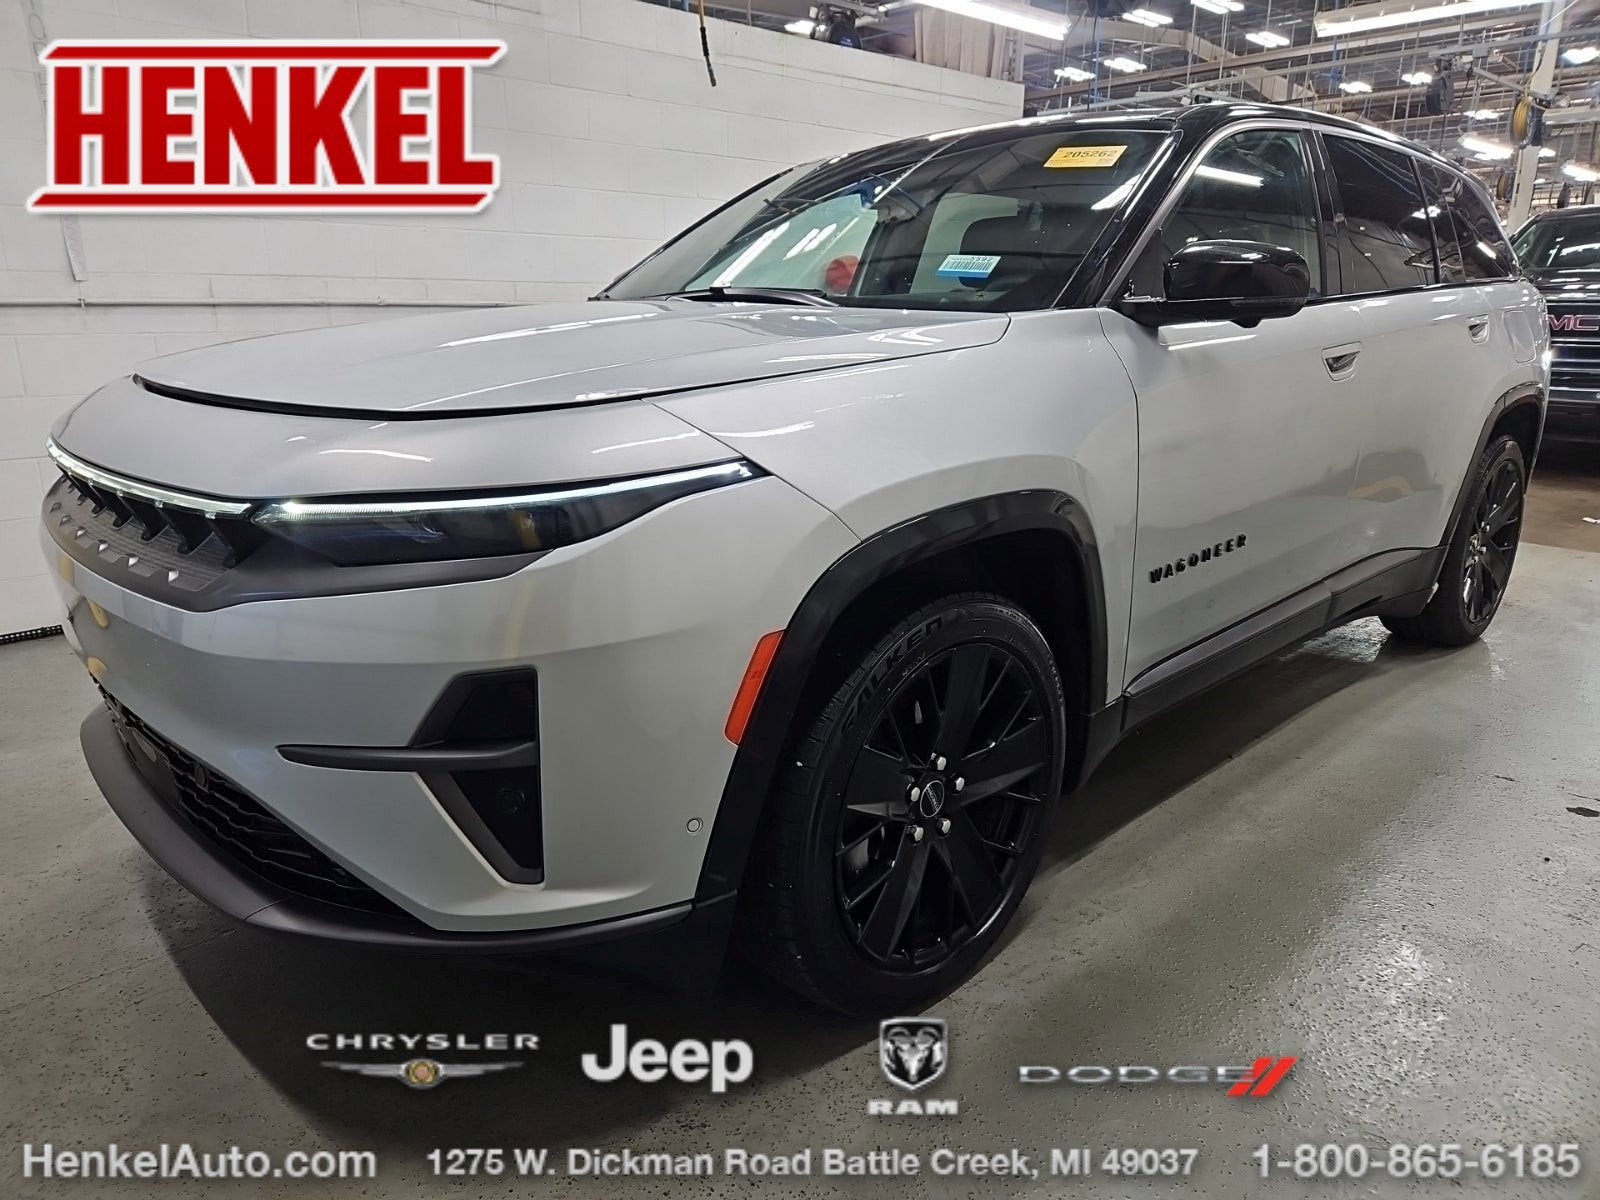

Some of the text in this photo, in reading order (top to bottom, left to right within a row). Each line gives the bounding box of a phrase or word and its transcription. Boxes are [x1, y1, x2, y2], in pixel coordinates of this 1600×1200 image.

[1063, 150, 1117, 159] 205262
[1547, 314, 1600, 331] MC
[1149, 533, 1247, 584] WAGONEER
